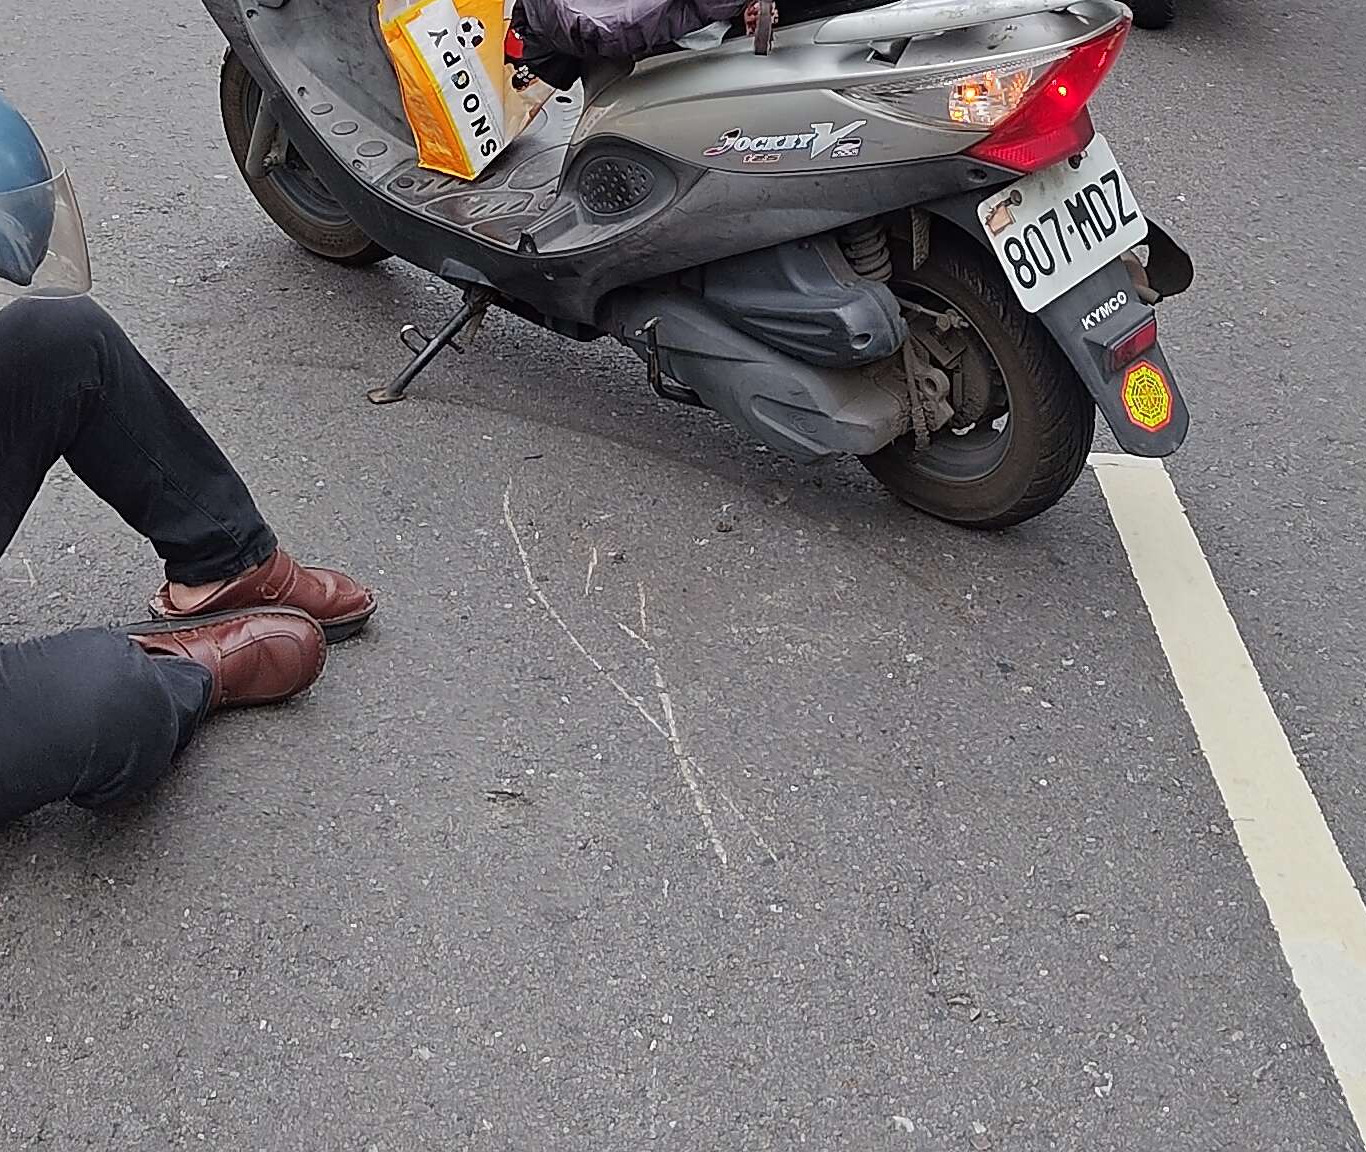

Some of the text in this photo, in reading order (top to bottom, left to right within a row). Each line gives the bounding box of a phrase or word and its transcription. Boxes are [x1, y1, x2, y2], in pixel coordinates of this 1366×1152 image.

[427, 26, 497, 158] SNOOPY
[1003, 169, 1138, 289] 807-MDZ
[1081, 291, 1128, 330] KYMCO
